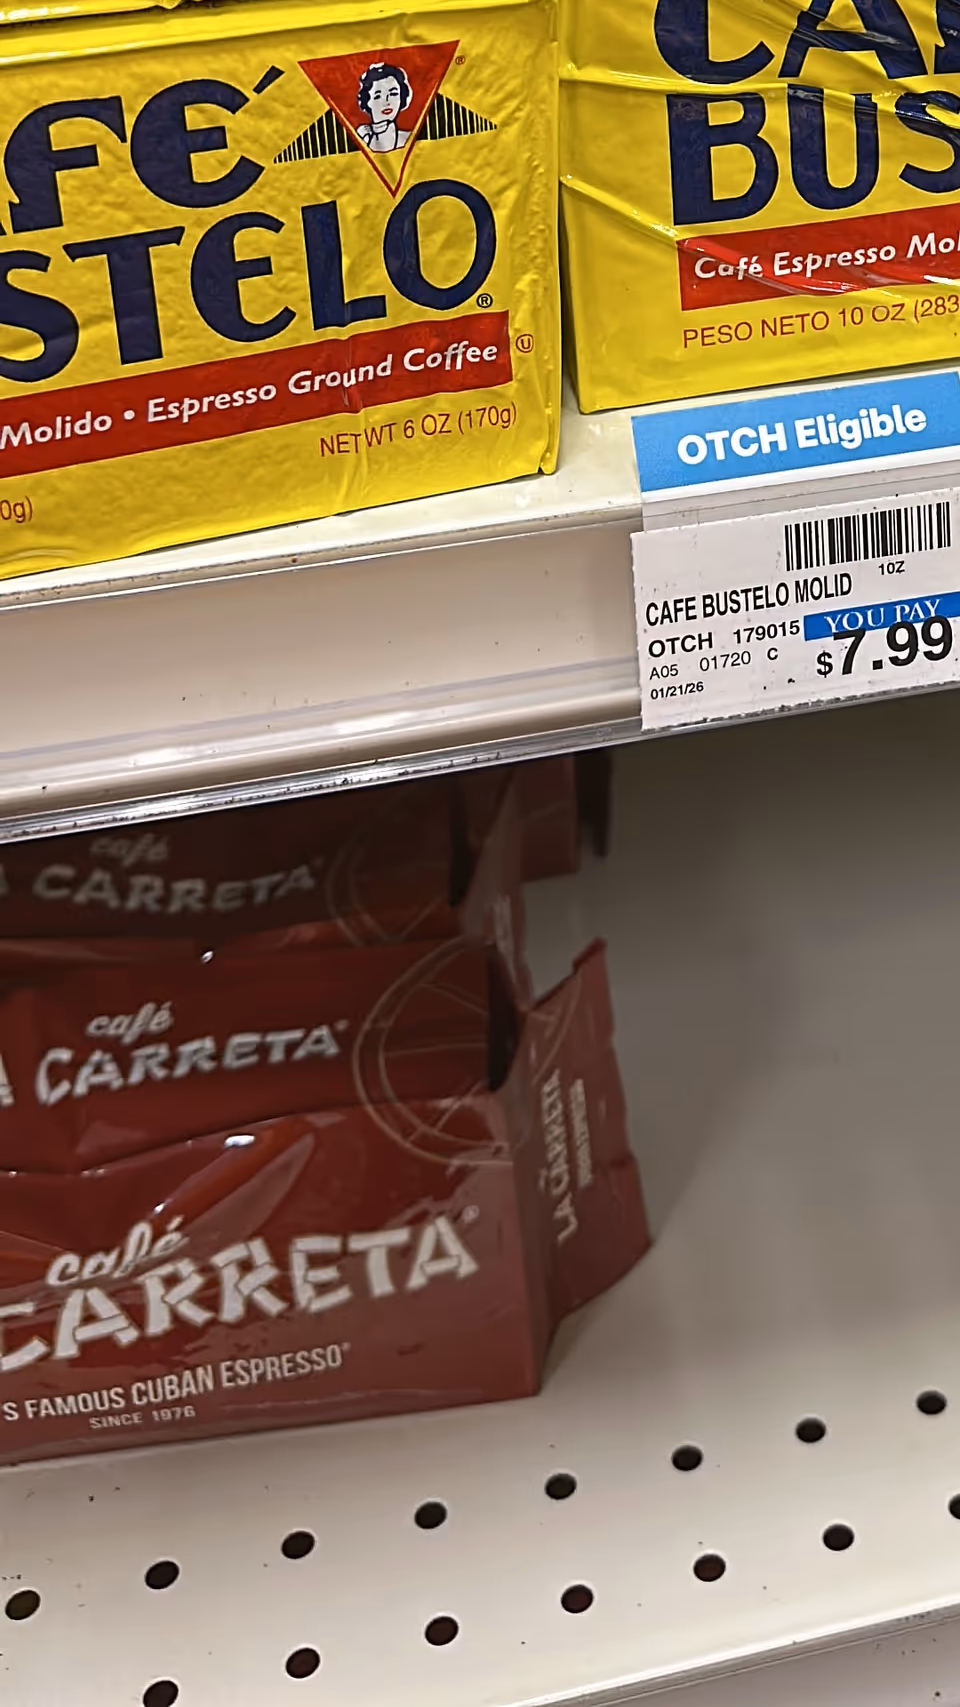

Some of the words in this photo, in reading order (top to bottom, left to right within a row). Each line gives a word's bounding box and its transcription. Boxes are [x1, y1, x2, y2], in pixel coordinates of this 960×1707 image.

[0, 65, 285, 235] FÉ
[0, 178, 497, 383] STELO
[695, 255, 763, 280] Café
[773, 245, 896, 278] Espresso
[683, 321, 753, 348] PESO
[761, 311, 830, 338] NETO
[838, 306, 864, 328] 10
[871, 303, 906, 323] OZ
[0, 409, 113, 451] Molido
[146, 381, 277, 424] Espresso
[288, 355, 393, 394] Ground
[403, 340, 498, 373] Coffee
[319, 433, 362, 457] NET
[364, 424, 399, 448] WT
[402, 418, 415, 440] 6
[420, 413, 451, 437] OZ
[457, 401, 517, 435] (170g)
[677, 422, 788, 465] OTCH
[794, 404, 928, 450] Eligible
[646, 596, 697, 627] CAFE
[702, 582, 790, 618] BUSTELO
[794, 572, 852, 604] MOLID
[648, 632, 714, 658] OTCH
[733, 619, 800, 644] 179015
[824, 606, 885, 634] YOU
[893, 598, 941, 624] PAY
[650, 664, 679, 680] A05
[699, 650, 751, 673] 01720
[767, 647, 779, 661] C
[816, 616, 954, 678] $7.99
[650, 680, 704, 700] 01/21/26
[32, 864, 315, 914] CARRETA
[86, 1001, 175, 1045] café
[35, 1025, 340, 1106] CARRETA
[46, 1216, 188, 1286] café
[0, 1215, 477, 1372] CARRETA
[24, 1387, 125, 1420] FAMOUS
[130, 1364, 214, 1404] CUBAN
[220, 1344, 343, 1388] ESPRESSO
[89, 1412, 143, 1430] SINCE
[152, 1406, 196, 1422] 1976
